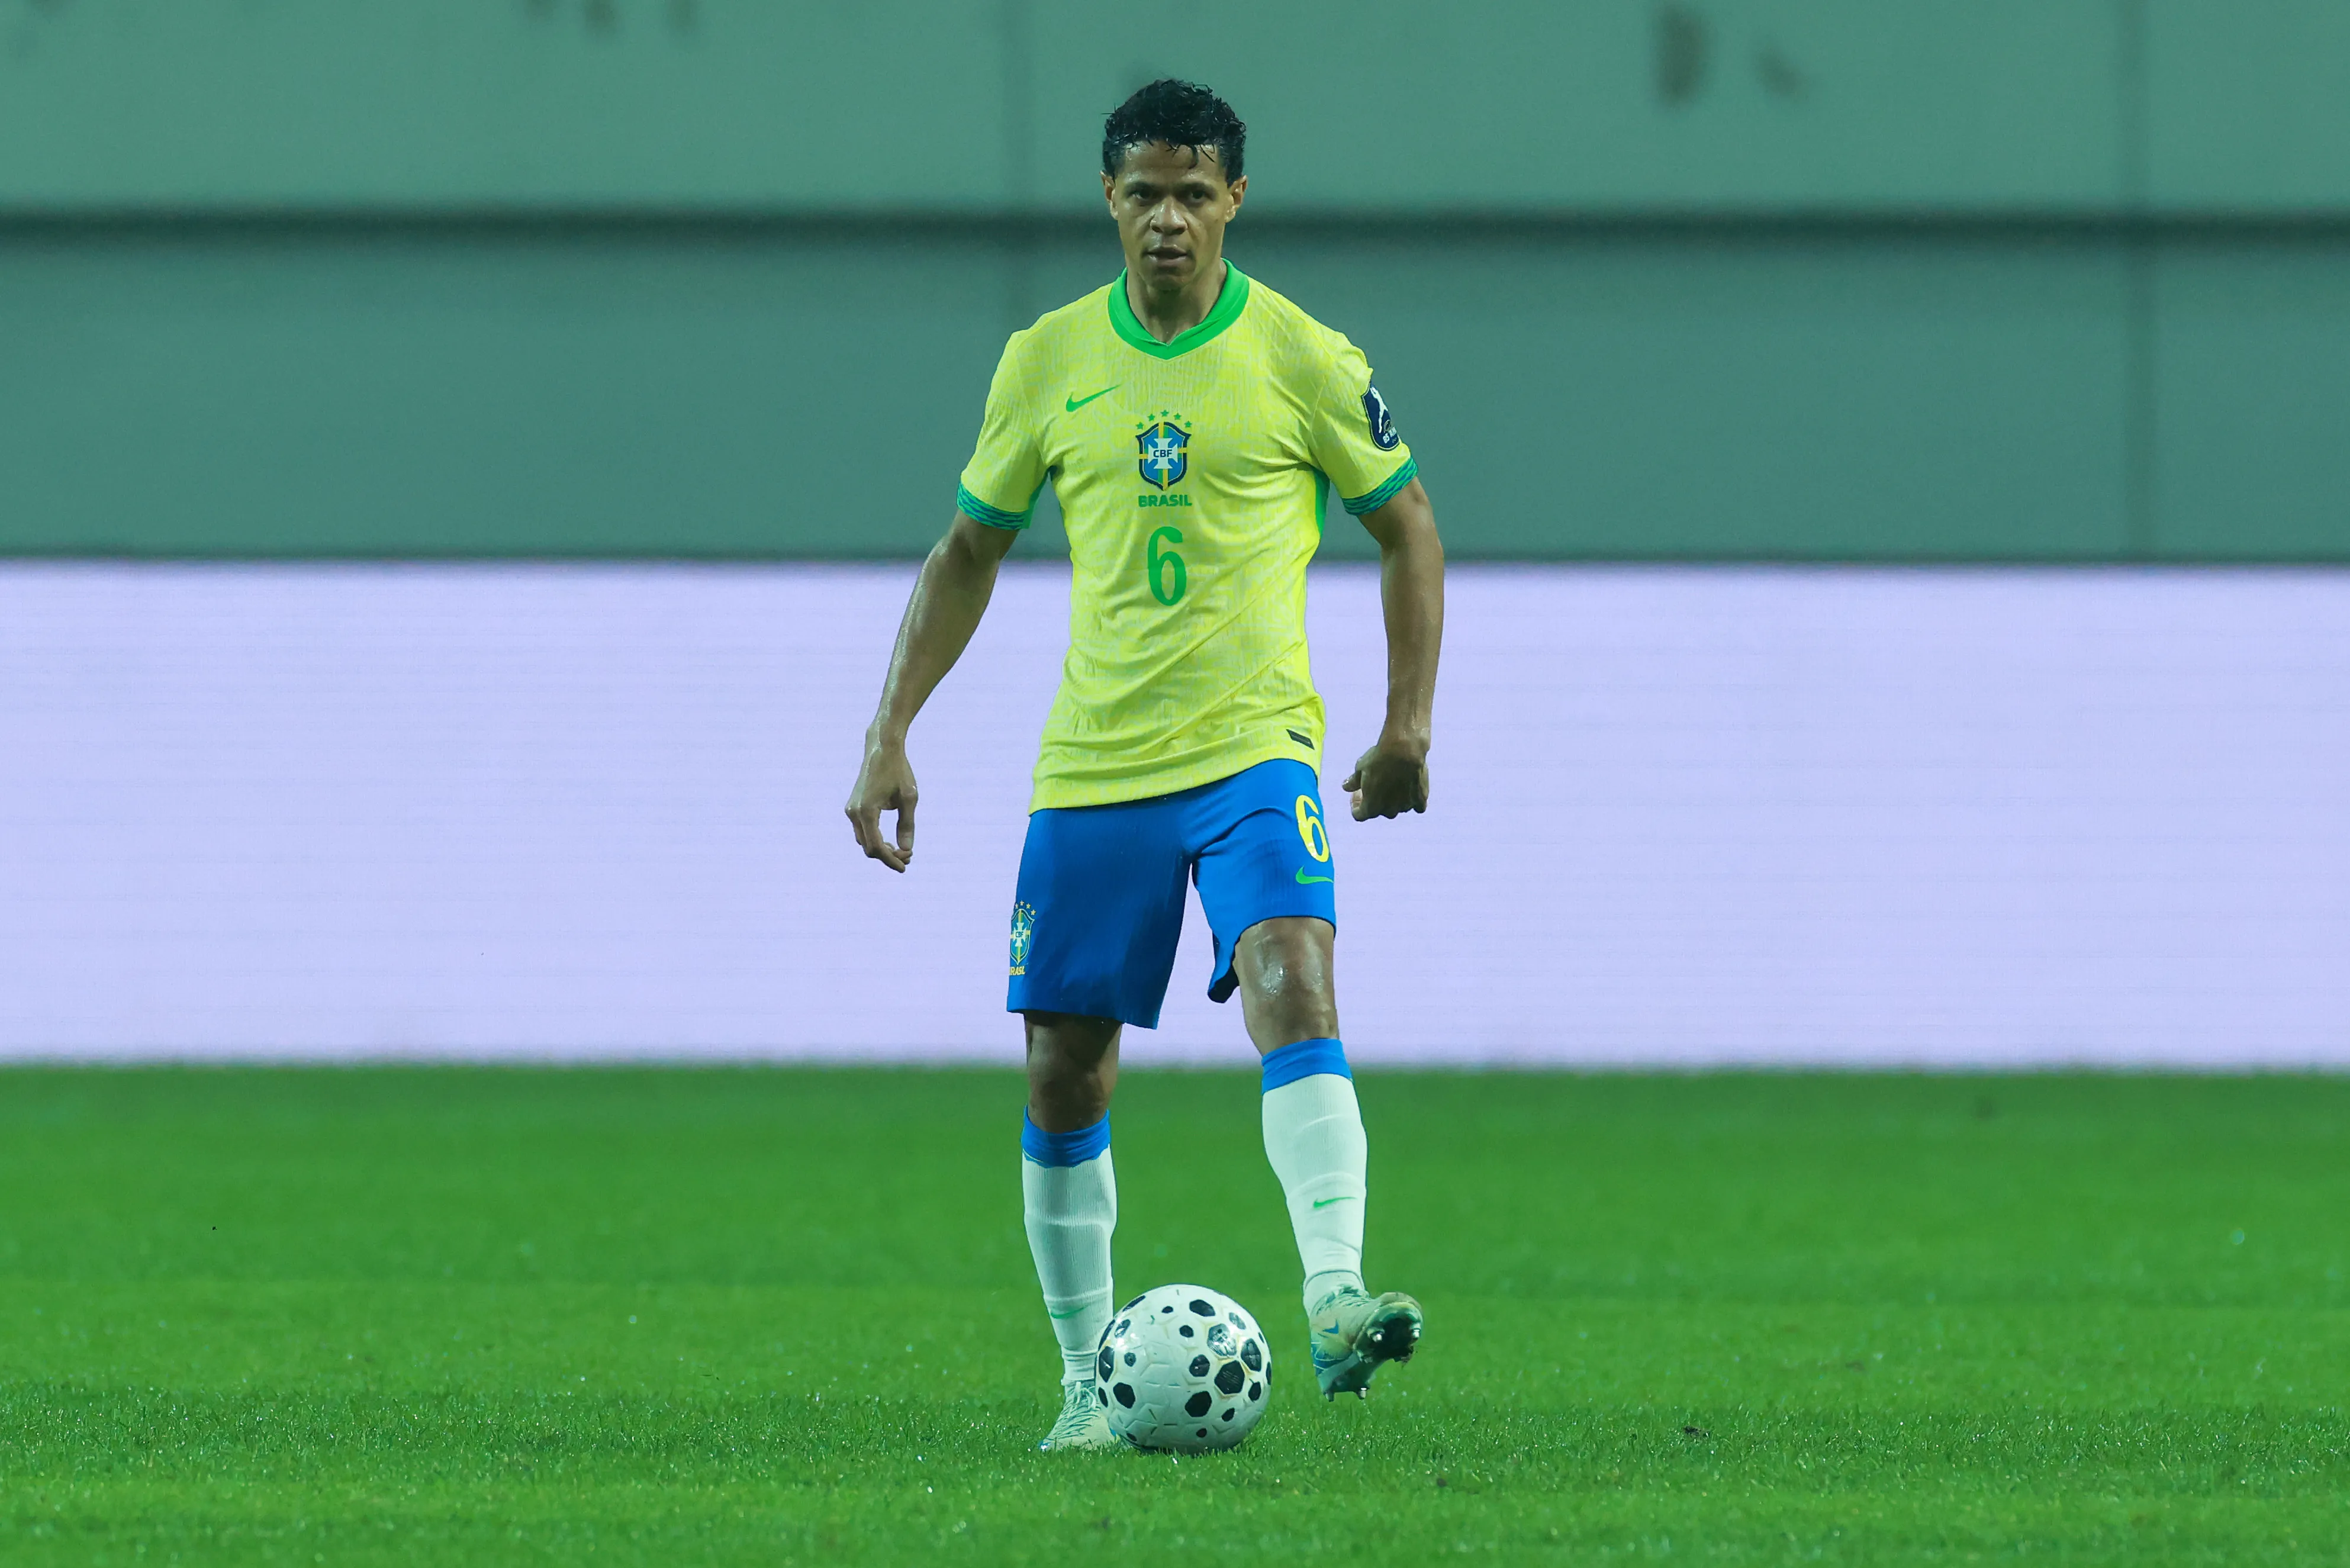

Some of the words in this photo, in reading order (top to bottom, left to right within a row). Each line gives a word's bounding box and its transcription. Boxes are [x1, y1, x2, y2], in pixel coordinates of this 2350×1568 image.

[1153, 449, 1173, 458] CBF
[1138, 494, 1193, 508] BRASIL
[1147, 526, 1187, 607] 6
[1295, 794, 1329, 863] 6
